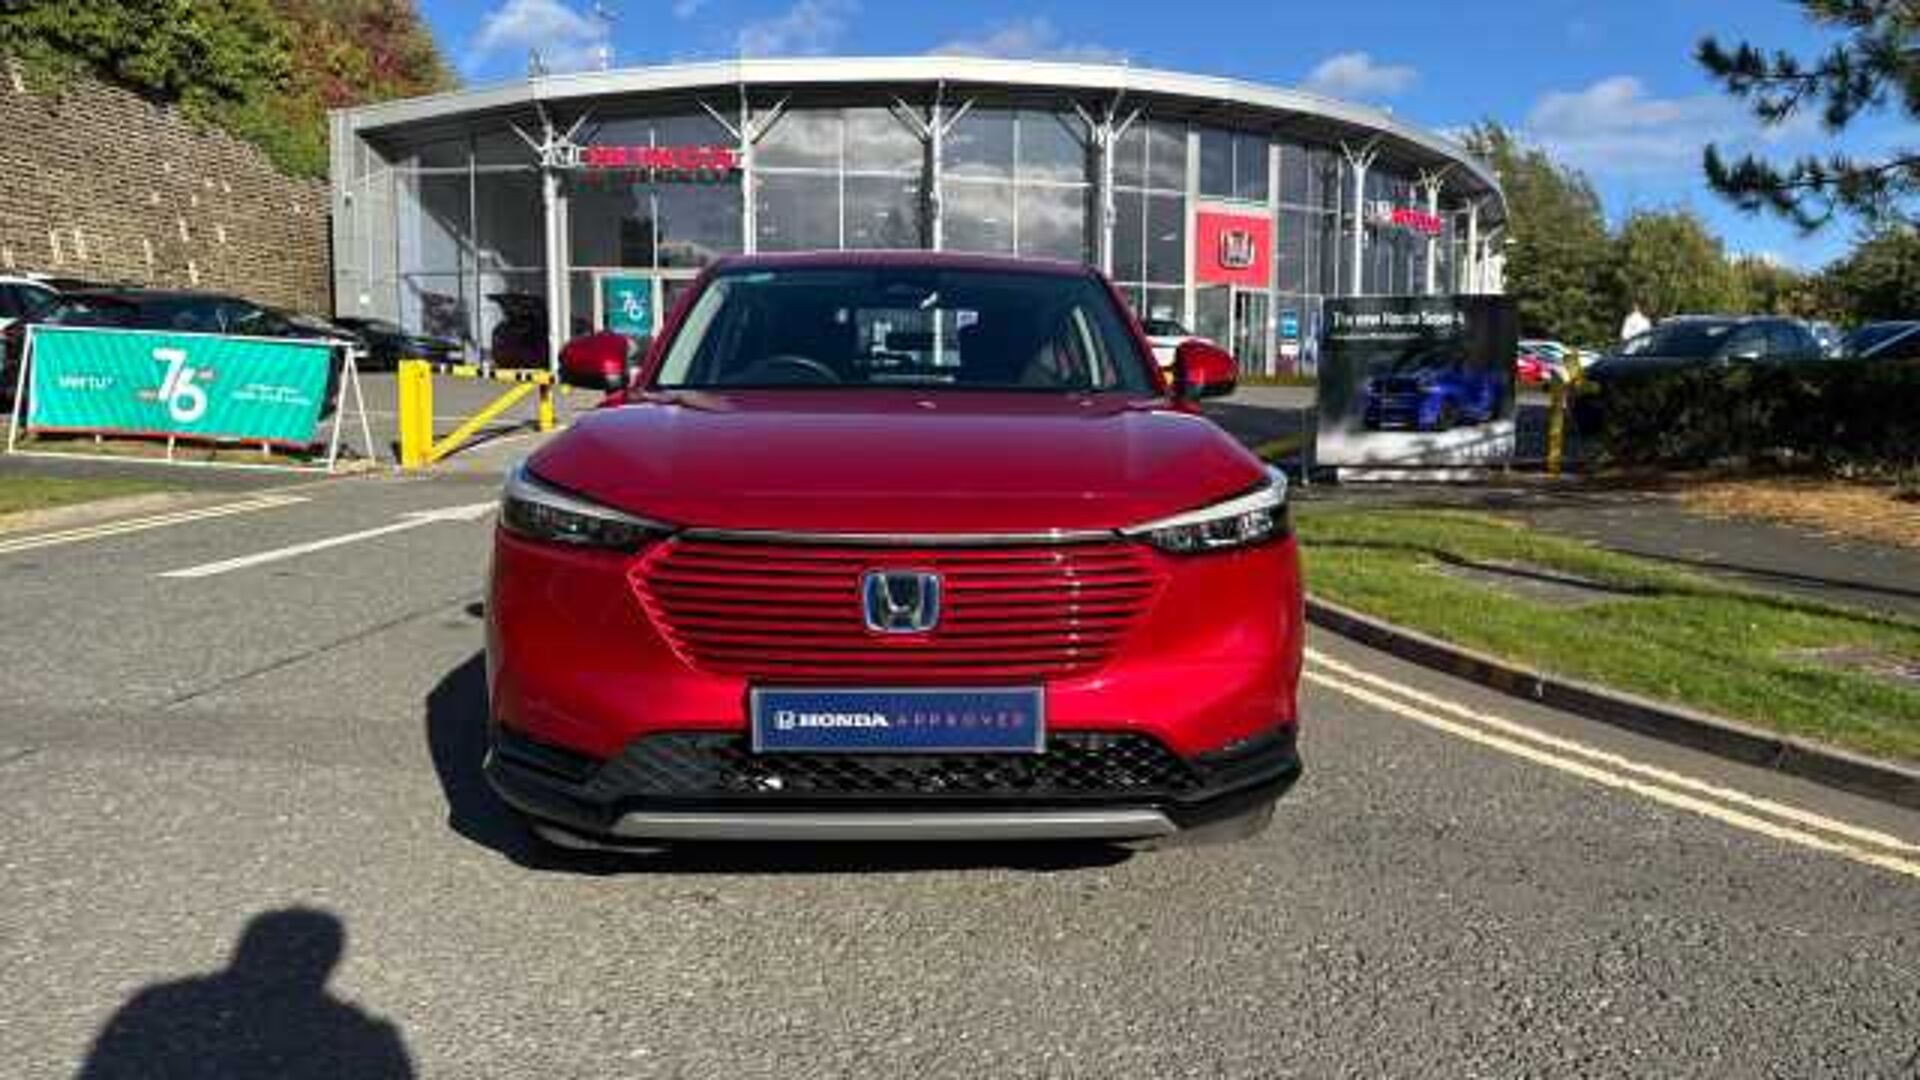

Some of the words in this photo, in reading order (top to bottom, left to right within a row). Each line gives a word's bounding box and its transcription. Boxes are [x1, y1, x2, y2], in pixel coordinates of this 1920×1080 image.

[152, 347, 207, 422] 76
[800, 712, 889, 728] HONDA
[896, 711, 1025, 728] APPROVED
